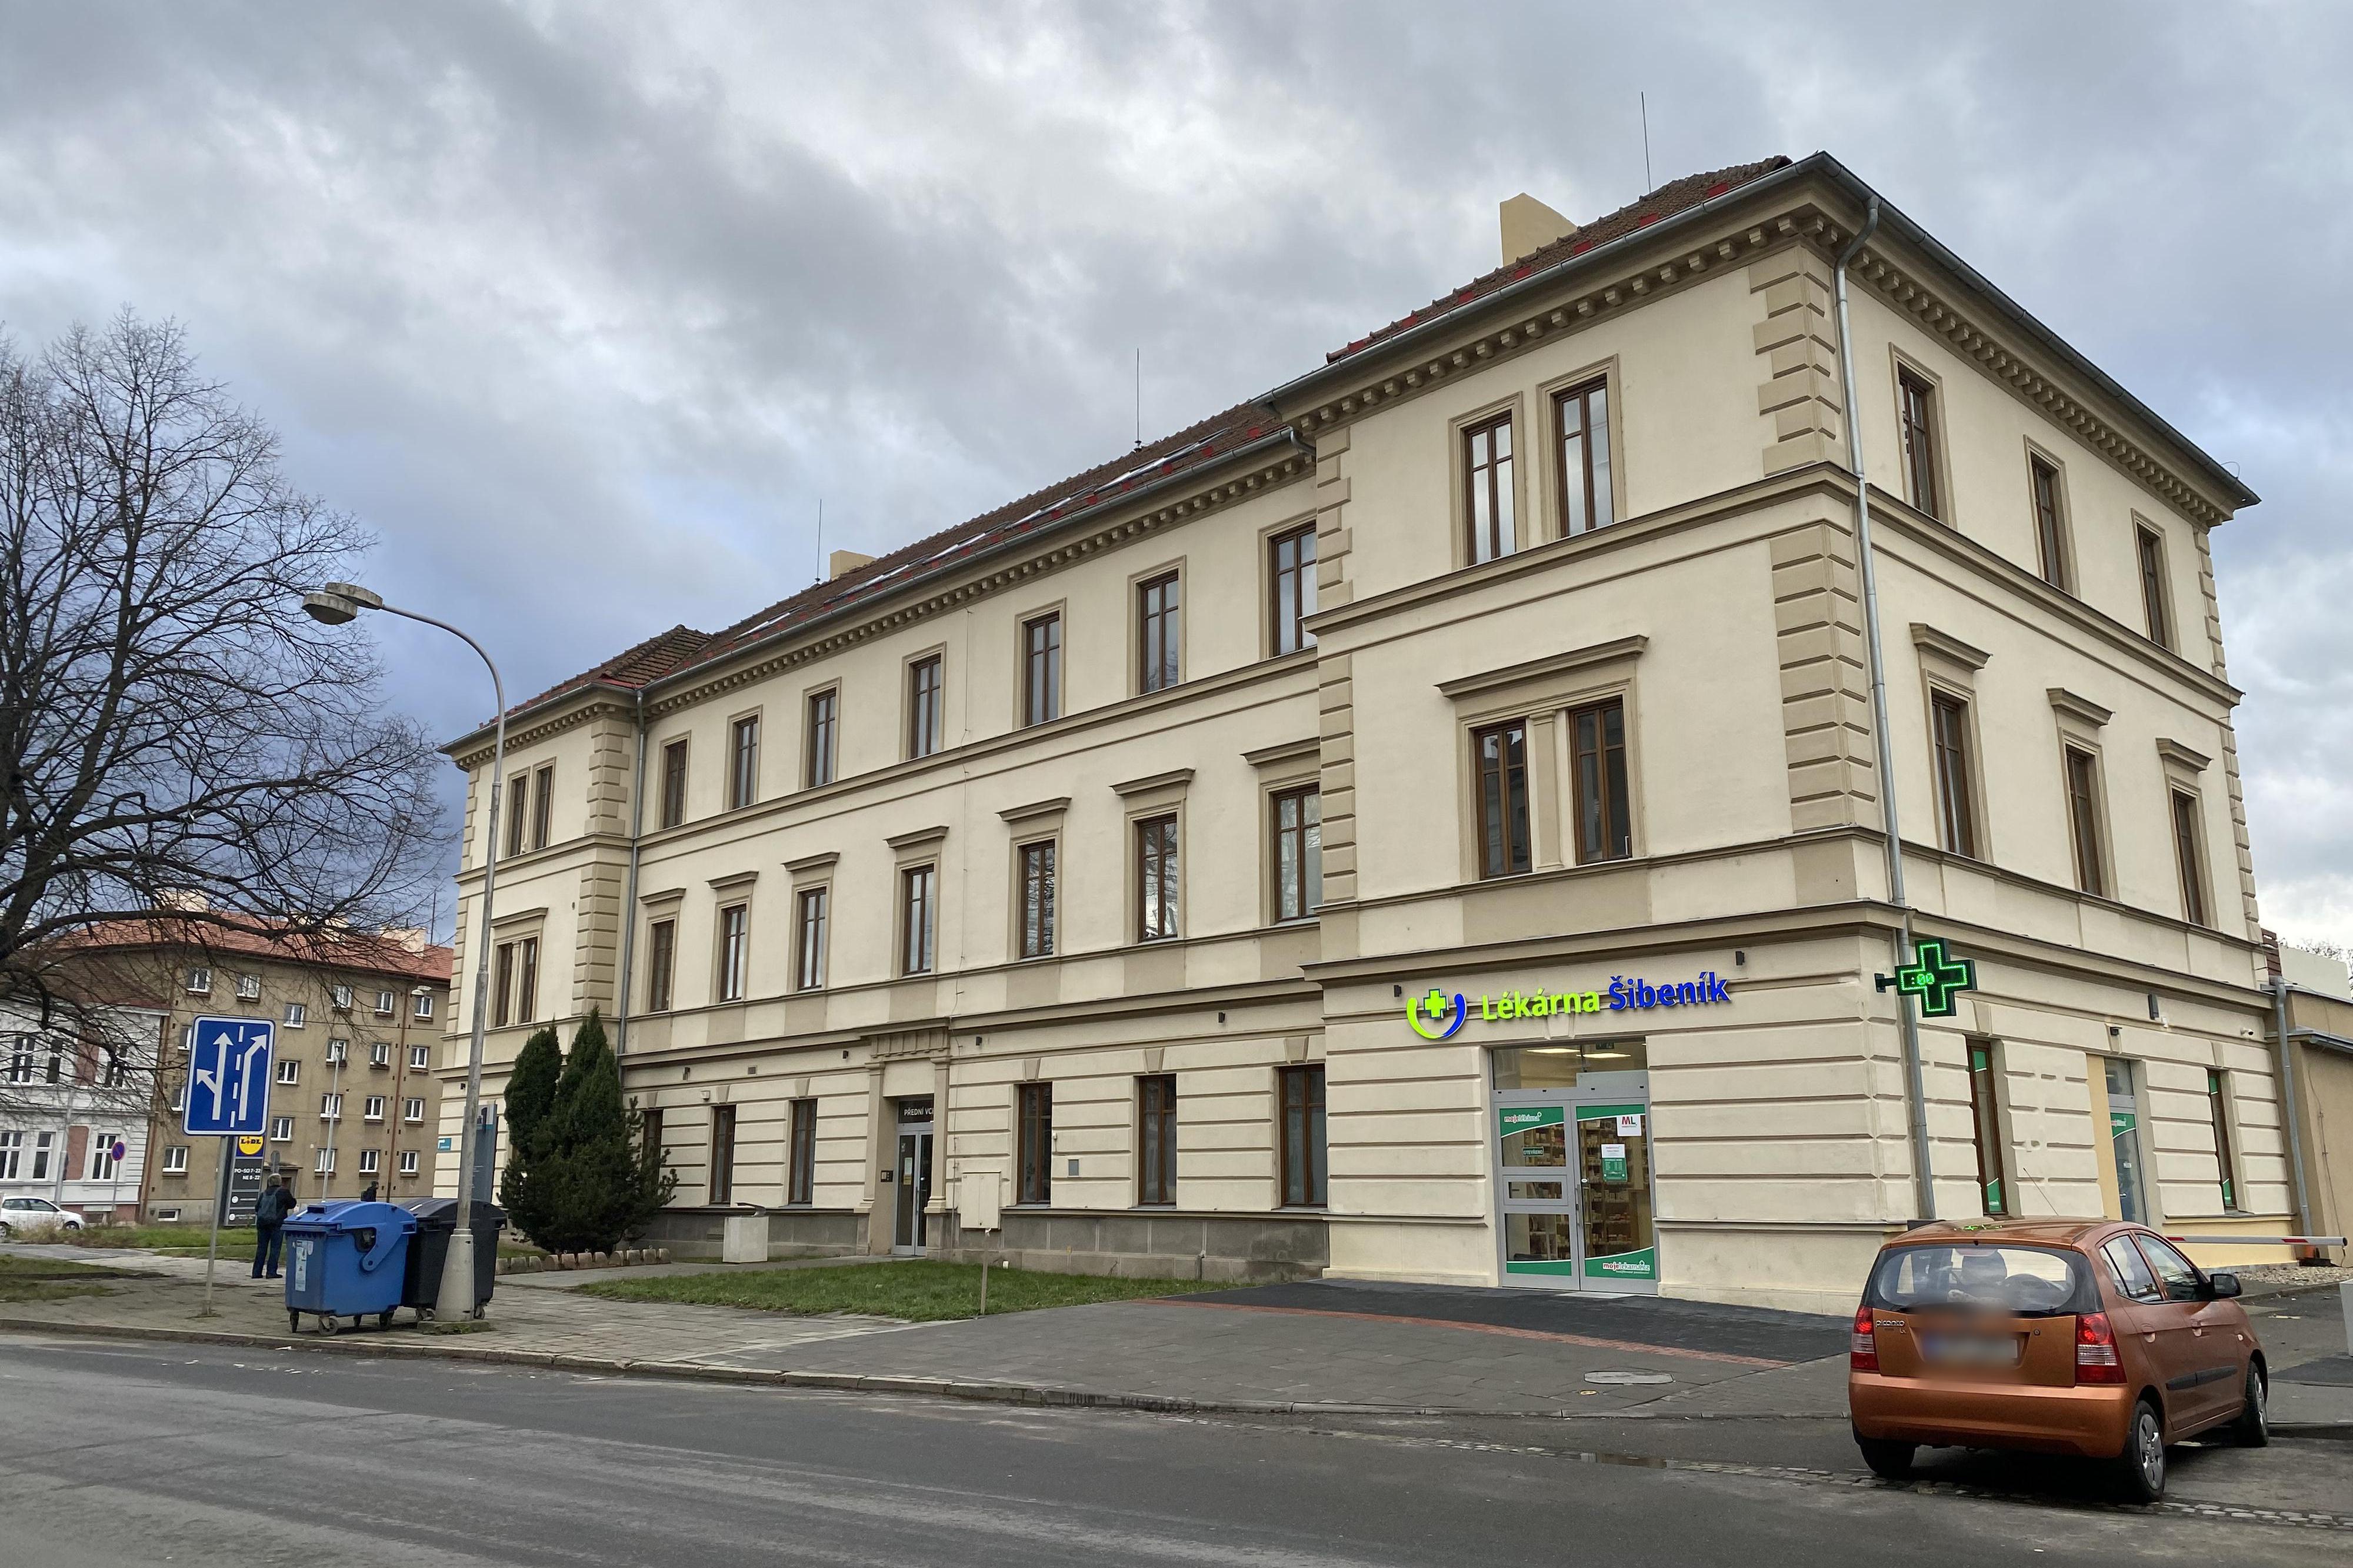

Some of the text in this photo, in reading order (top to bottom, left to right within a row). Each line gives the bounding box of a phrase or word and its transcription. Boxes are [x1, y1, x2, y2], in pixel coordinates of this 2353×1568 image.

[1481, 971, 1732, 1021] Lékárna Šibeník
[904, 1106, 924, 1116] PŘEDNÍ
[241, 1136, 261, 1145] LIDL
